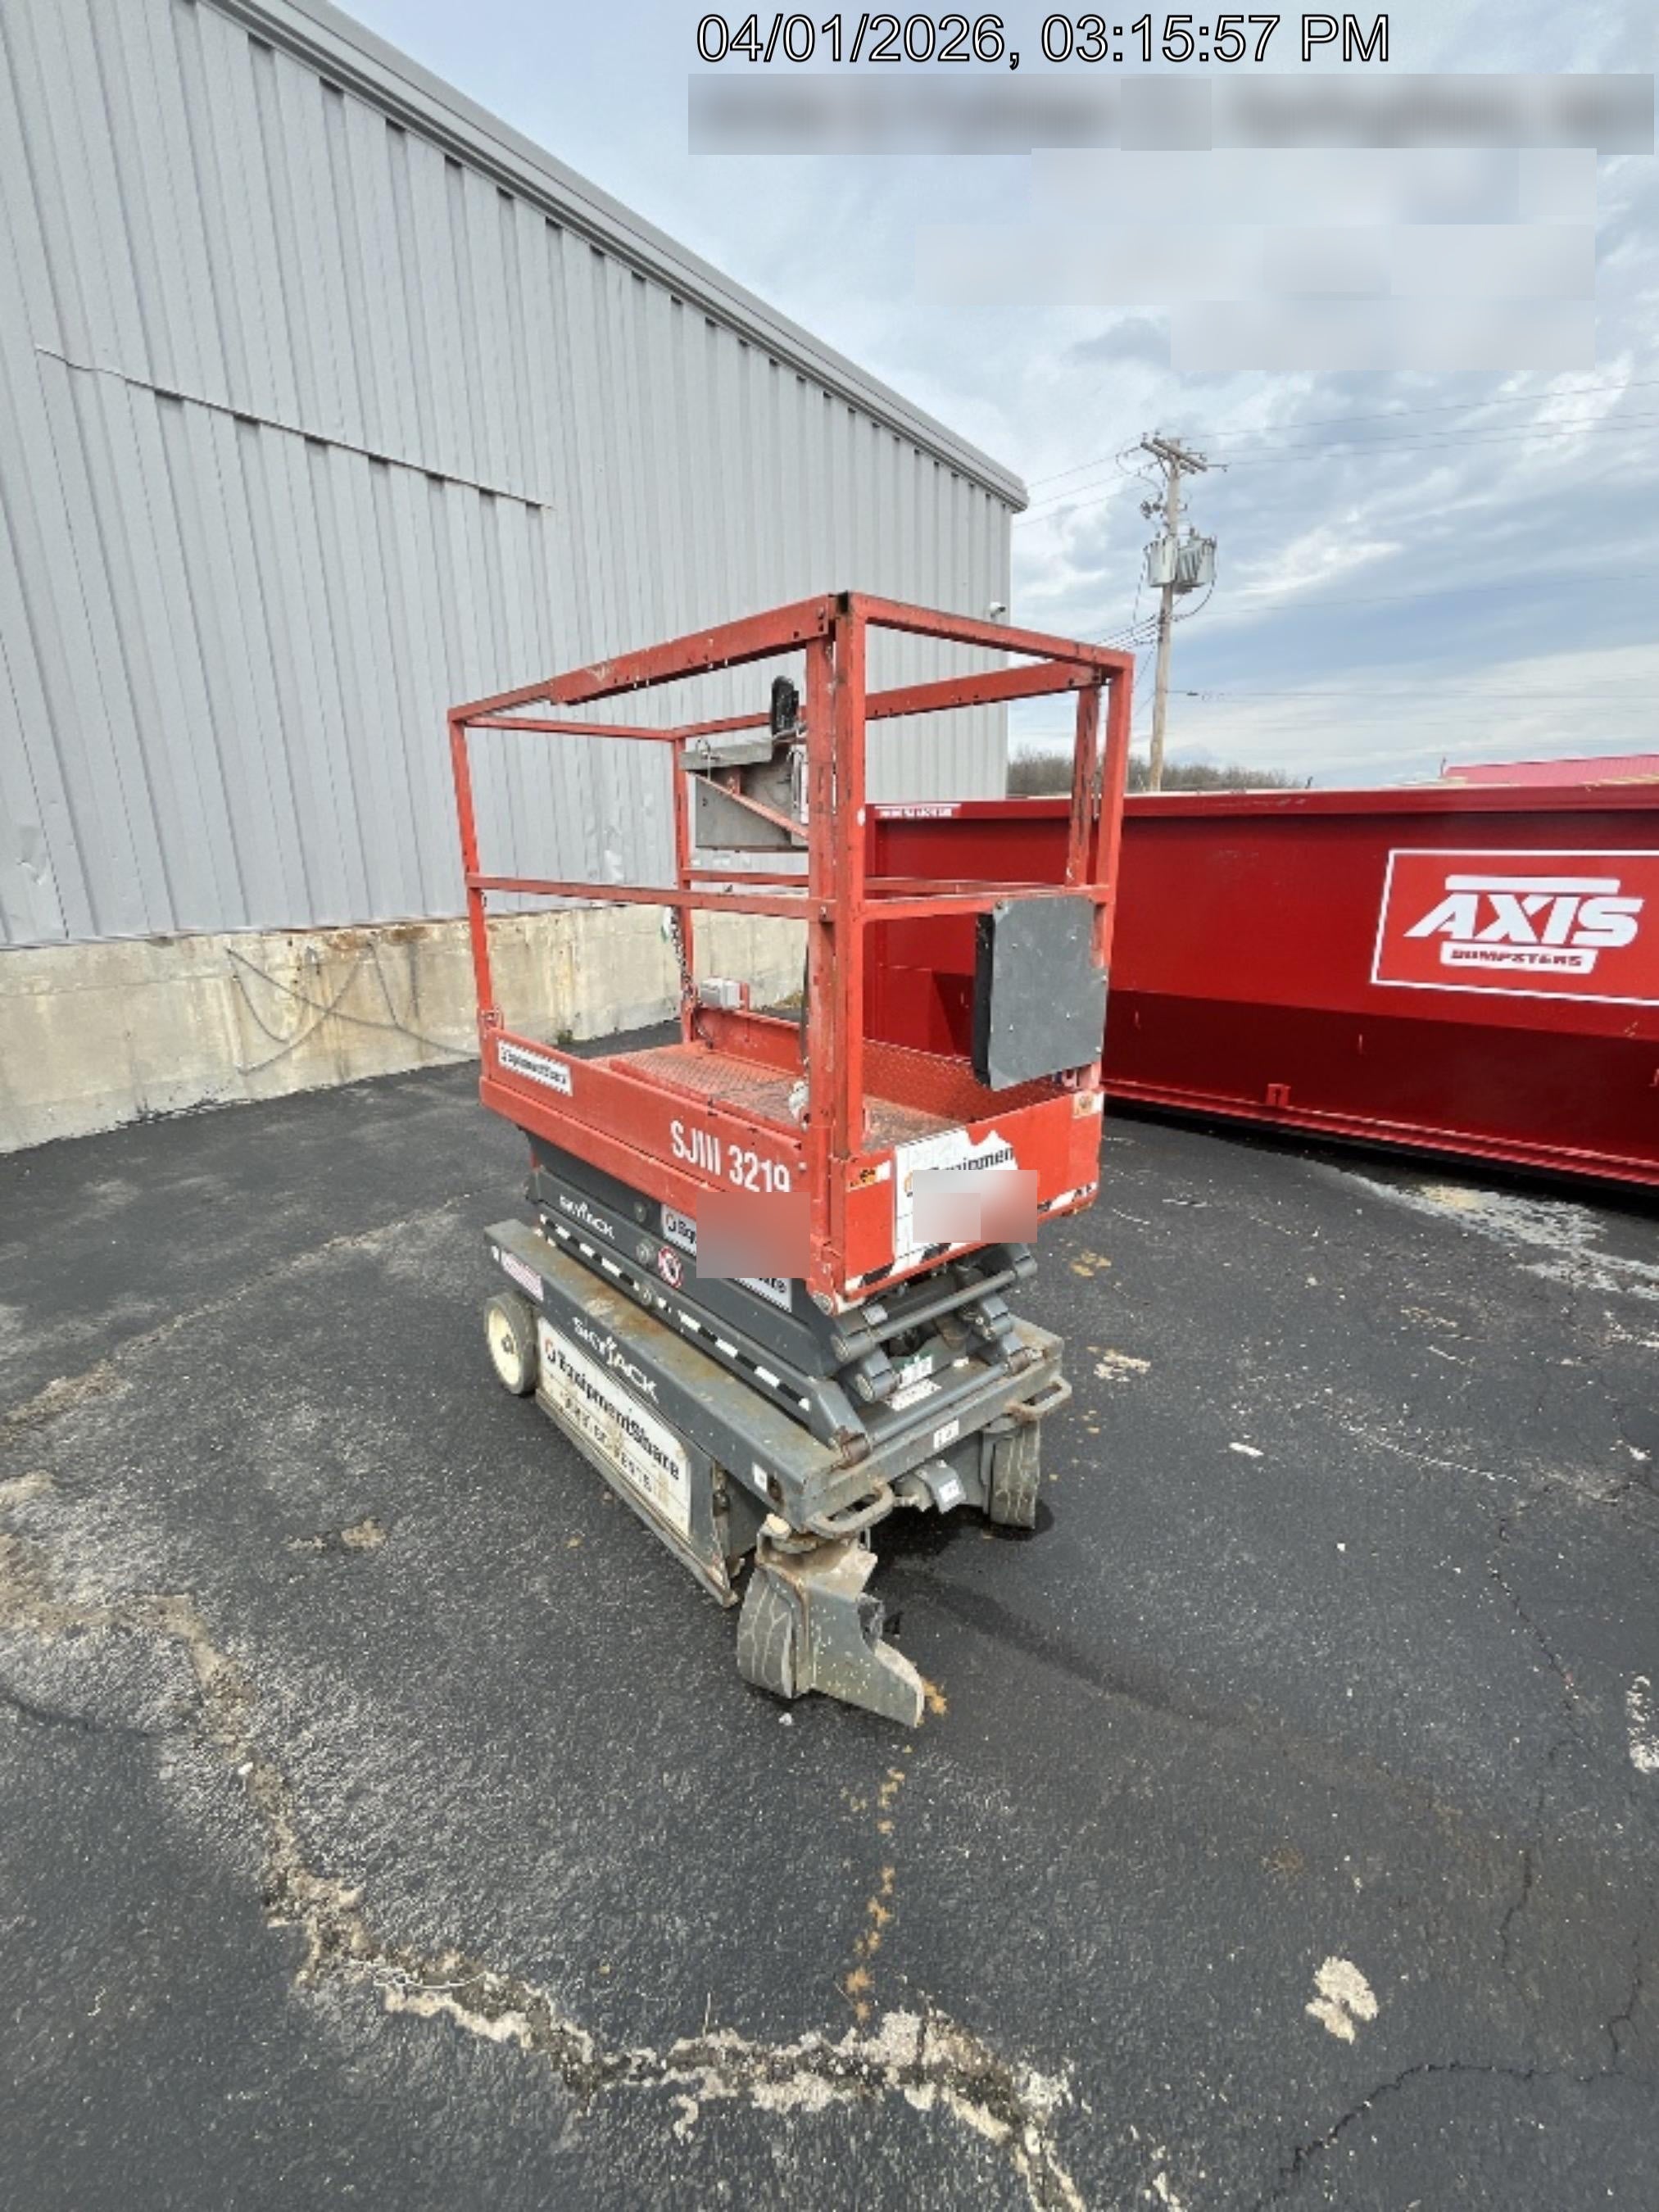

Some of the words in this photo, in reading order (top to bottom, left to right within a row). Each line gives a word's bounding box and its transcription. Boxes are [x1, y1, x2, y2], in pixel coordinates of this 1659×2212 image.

[1403, 892, 1644, 947] AXIS
[1450, 949, 1582, 967] DUMPSTERS
[728, 1144, 791, 1192] 3219
[558, 1351, 680, 1481] EquipmentShare
